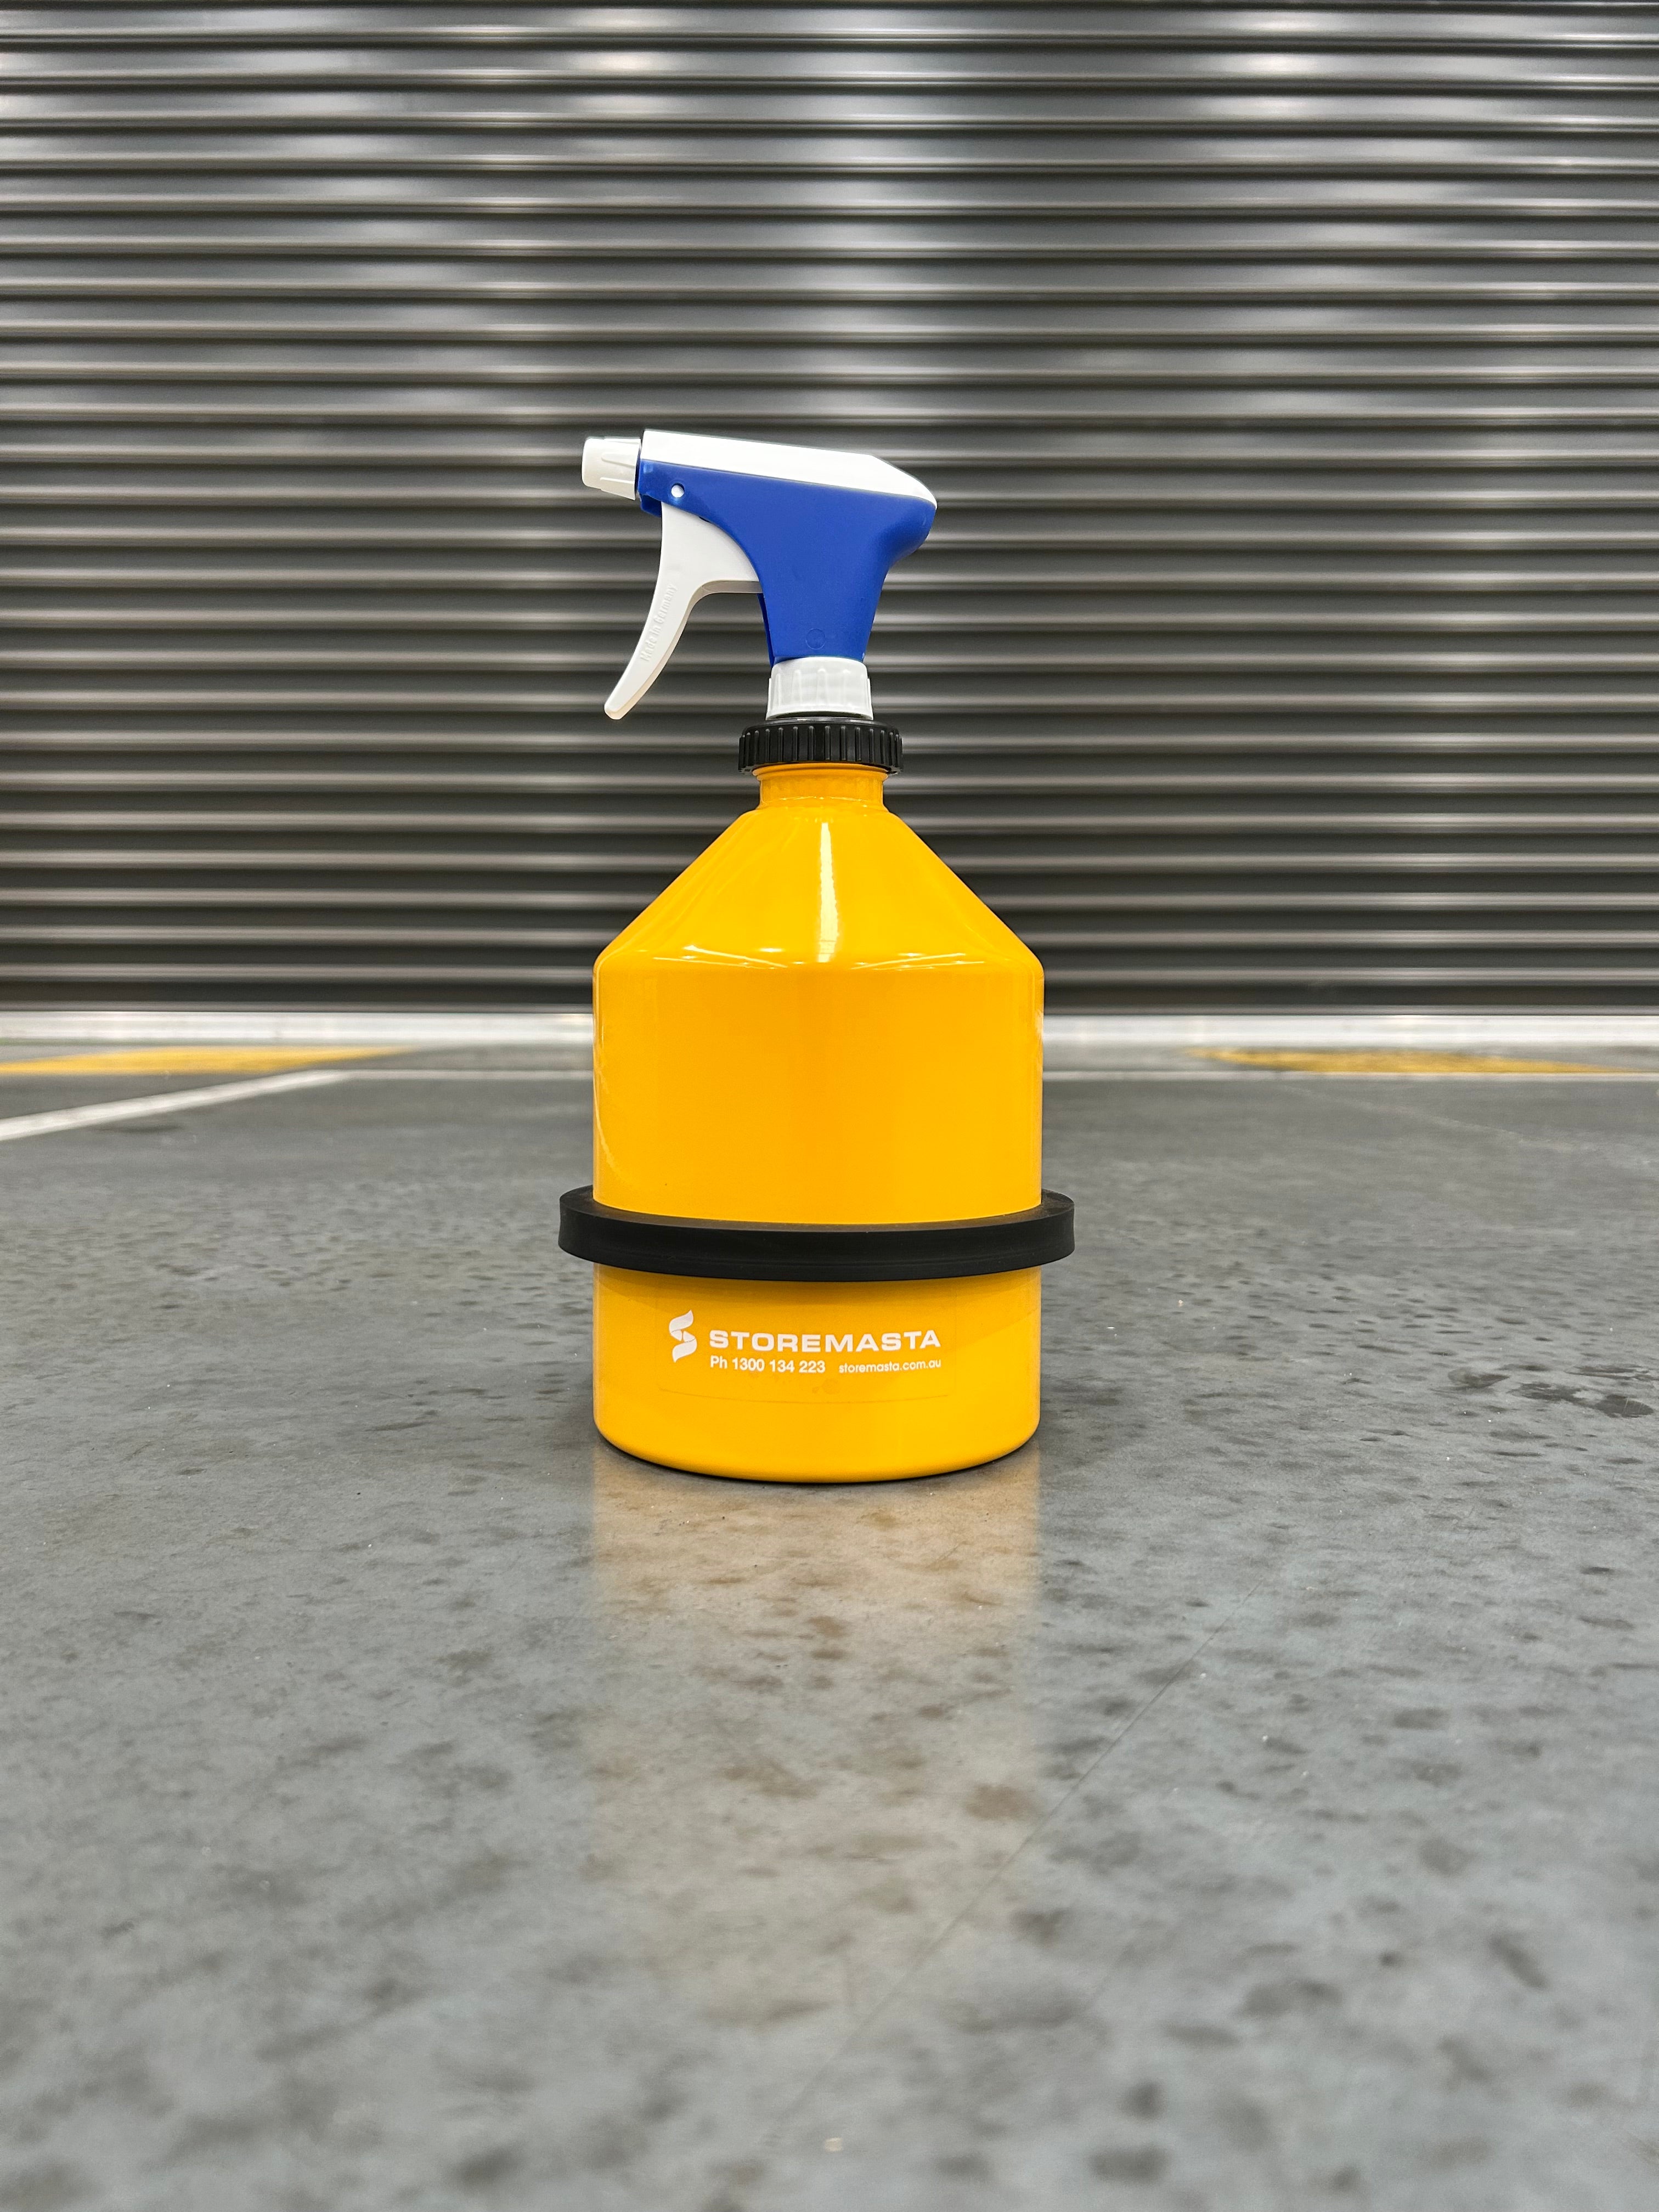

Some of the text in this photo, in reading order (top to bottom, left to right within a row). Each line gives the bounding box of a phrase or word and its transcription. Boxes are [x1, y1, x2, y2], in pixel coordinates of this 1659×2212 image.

[640, 637, 657, 662] Made
[653, 584, 678, 624] Germany
[709, 1330, 941, 1352] STOREMASTA
[710, 1355, 826, 1373] Ph 1300 134 223
[839, 1359, 941, 1373] storemasta.com.au
